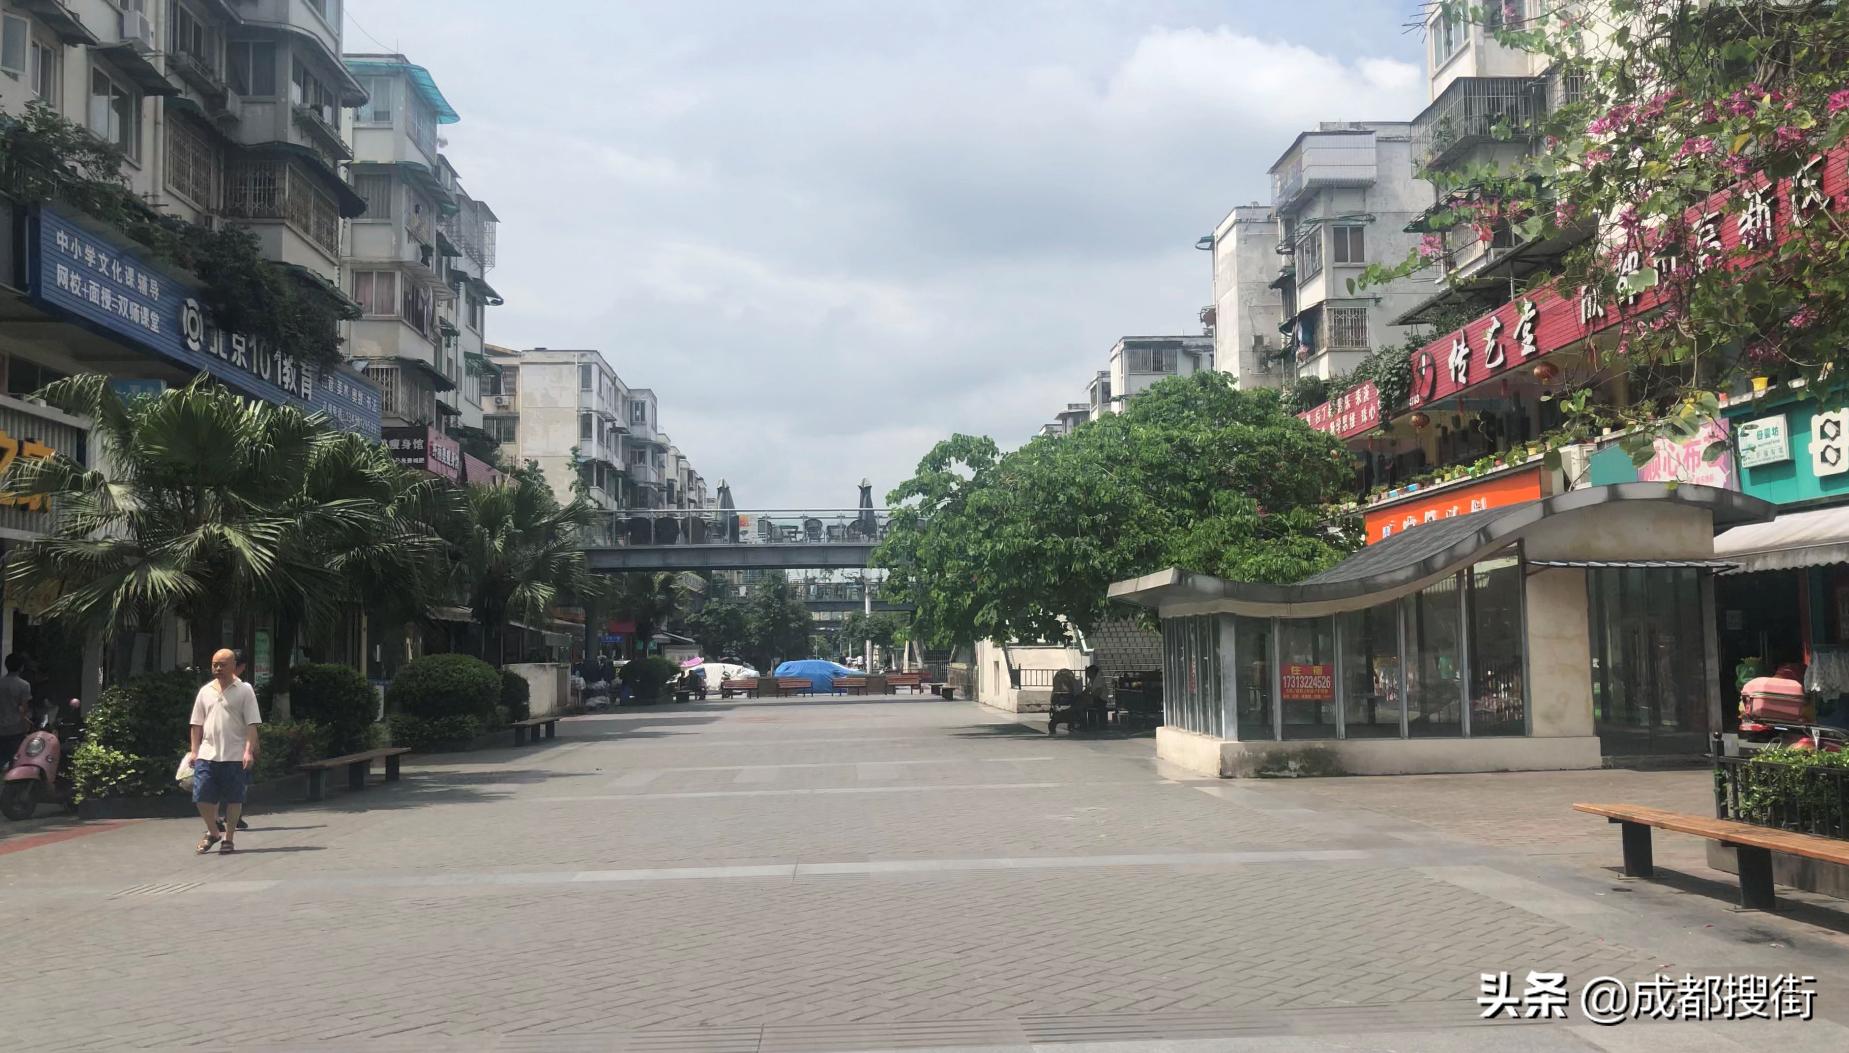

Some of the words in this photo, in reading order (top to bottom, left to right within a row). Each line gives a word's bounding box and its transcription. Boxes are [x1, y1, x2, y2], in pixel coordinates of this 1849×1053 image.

[56, 229, 160, 301] 中小学文化课辅导
[56, 263, 160, 334] 网校+面授=双师课堂
[1447, 297, 1537, 385] 传艺堂
[1282, 675, 1331, 689] 17313224526
